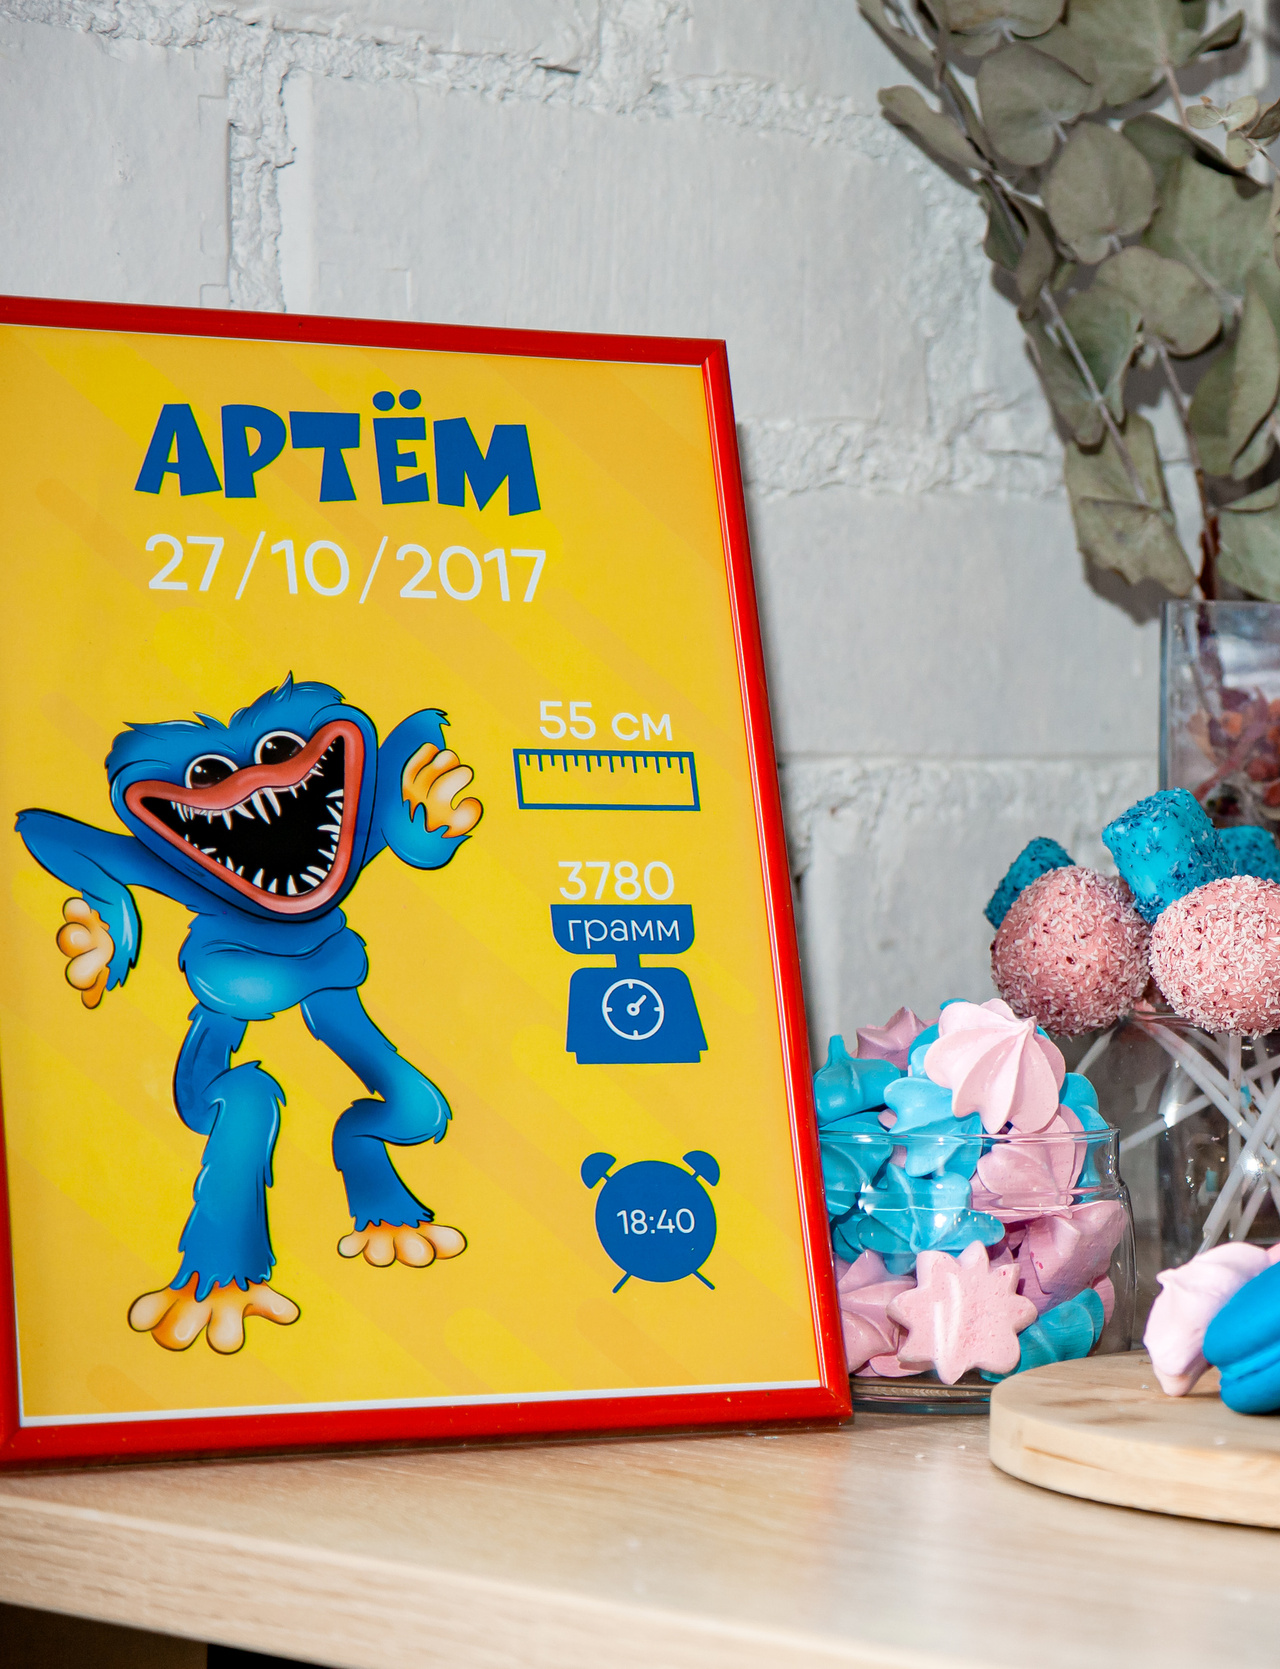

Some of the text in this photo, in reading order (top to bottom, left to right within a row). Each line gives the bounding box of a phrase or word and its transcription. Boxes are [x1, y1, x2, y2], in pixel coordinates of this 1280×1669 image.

[134, 389, 541, 516] АРТЁМ
[145, 531, 547, 604] 27/10/2017
[539, 700, 673, 741] 55 см
[557, 860, 675, 901] 3780
[567, 919, 680, 949] грамм
[616, 1208, 696, 1235] 18:40
